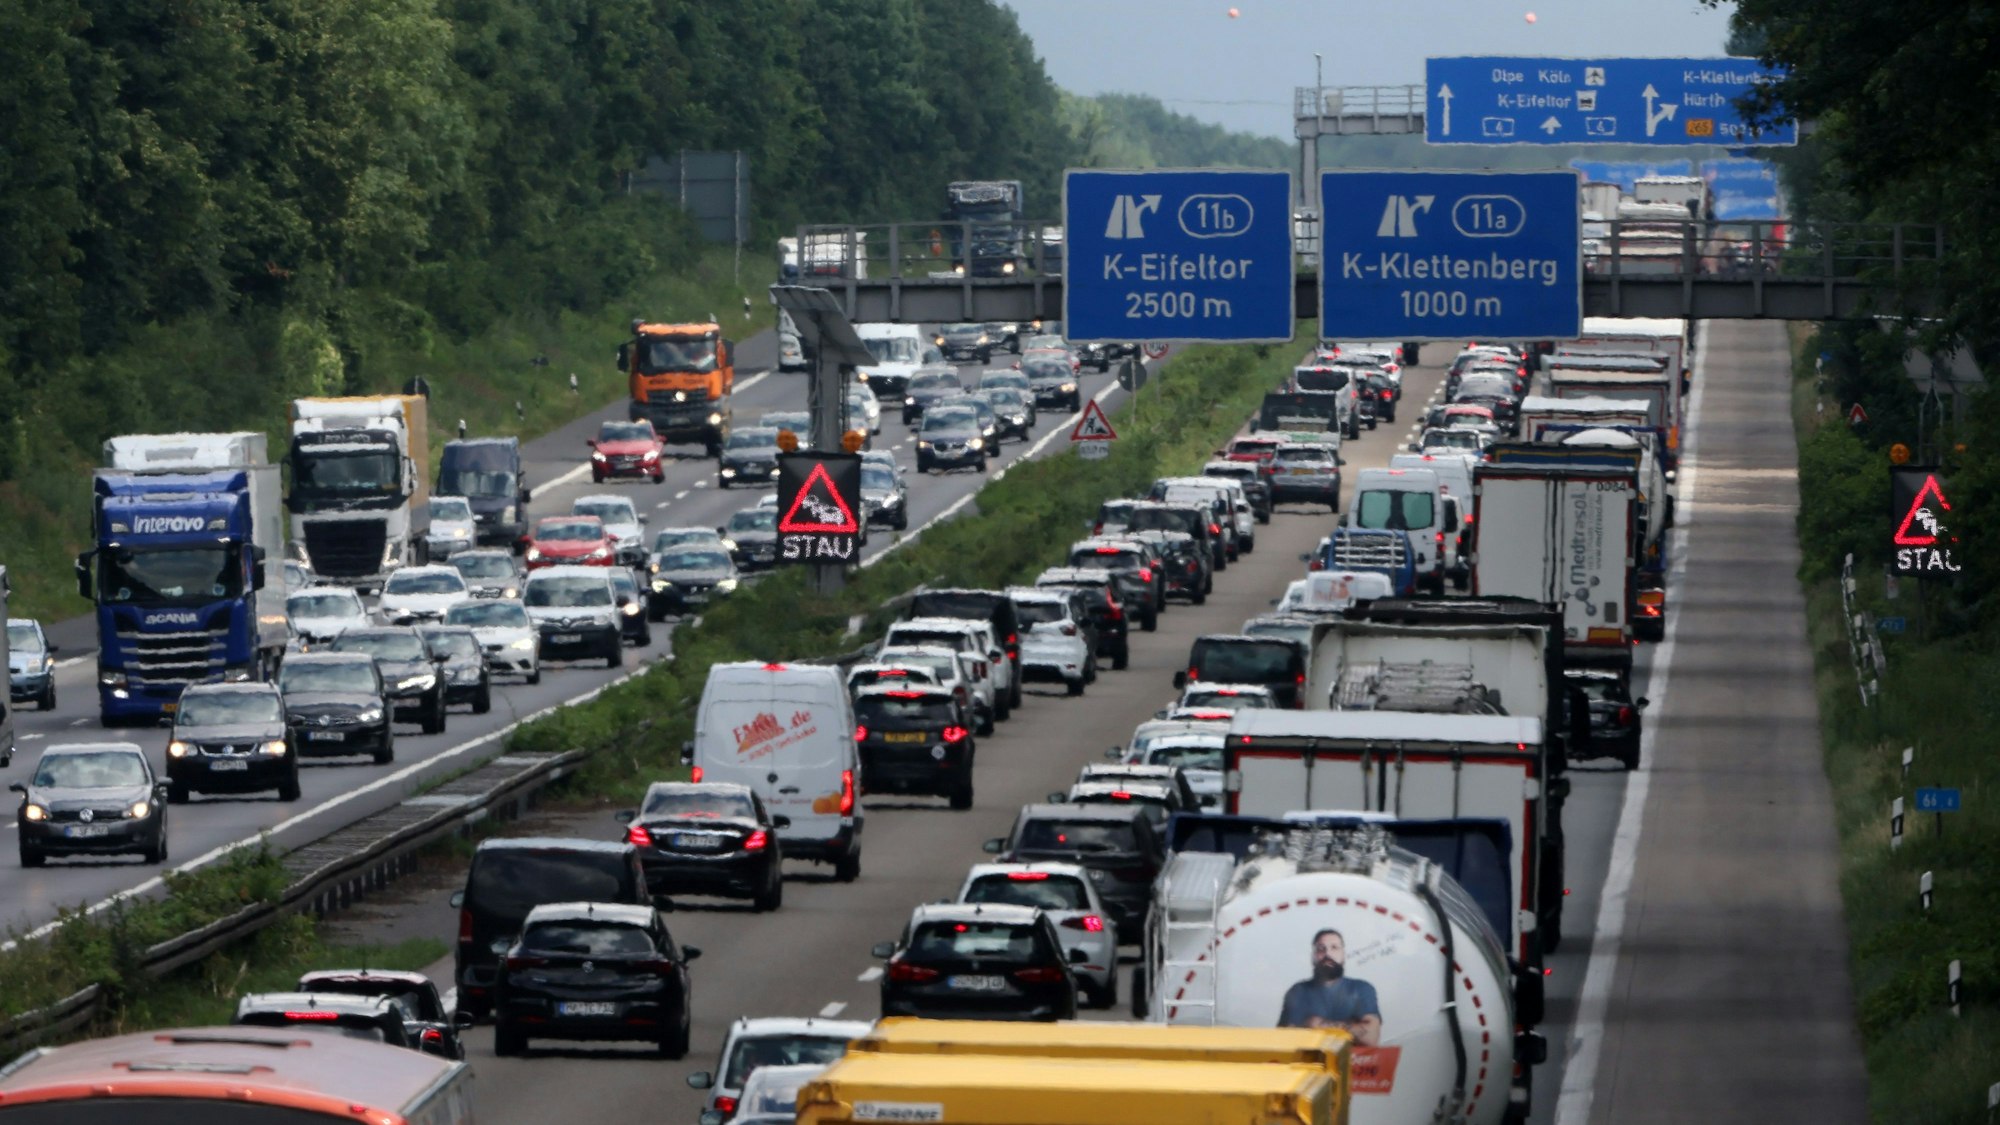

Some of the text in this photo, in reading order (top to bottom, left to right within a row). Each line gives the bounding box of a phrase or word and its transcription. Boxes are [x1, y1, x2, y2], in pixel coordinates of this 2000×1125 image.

[1492, 68, 1572, 85] Olpe Köln
[1498, 94, 1572, 109] K-Eifeltor
[1683, 92, 1726, 108] Hürth
[1494, 120, 1504, 134] 4
[1595, 120, 1606, 133] 4
[1196, 201, 1236, 230] 11b
[1471, 202, 1507, 230] 11a
[1103, 252, 1254, 281] K-Eifeltor
[1342, 252, 1558, 286] K-Klettenberg
[1125, 291, 1233, 319] 2500 m
[1401, 290, 1503, 318] 1000 m
[782, 534, 854, 560] STAU
[145, 612, 199, 625] SCANIA
